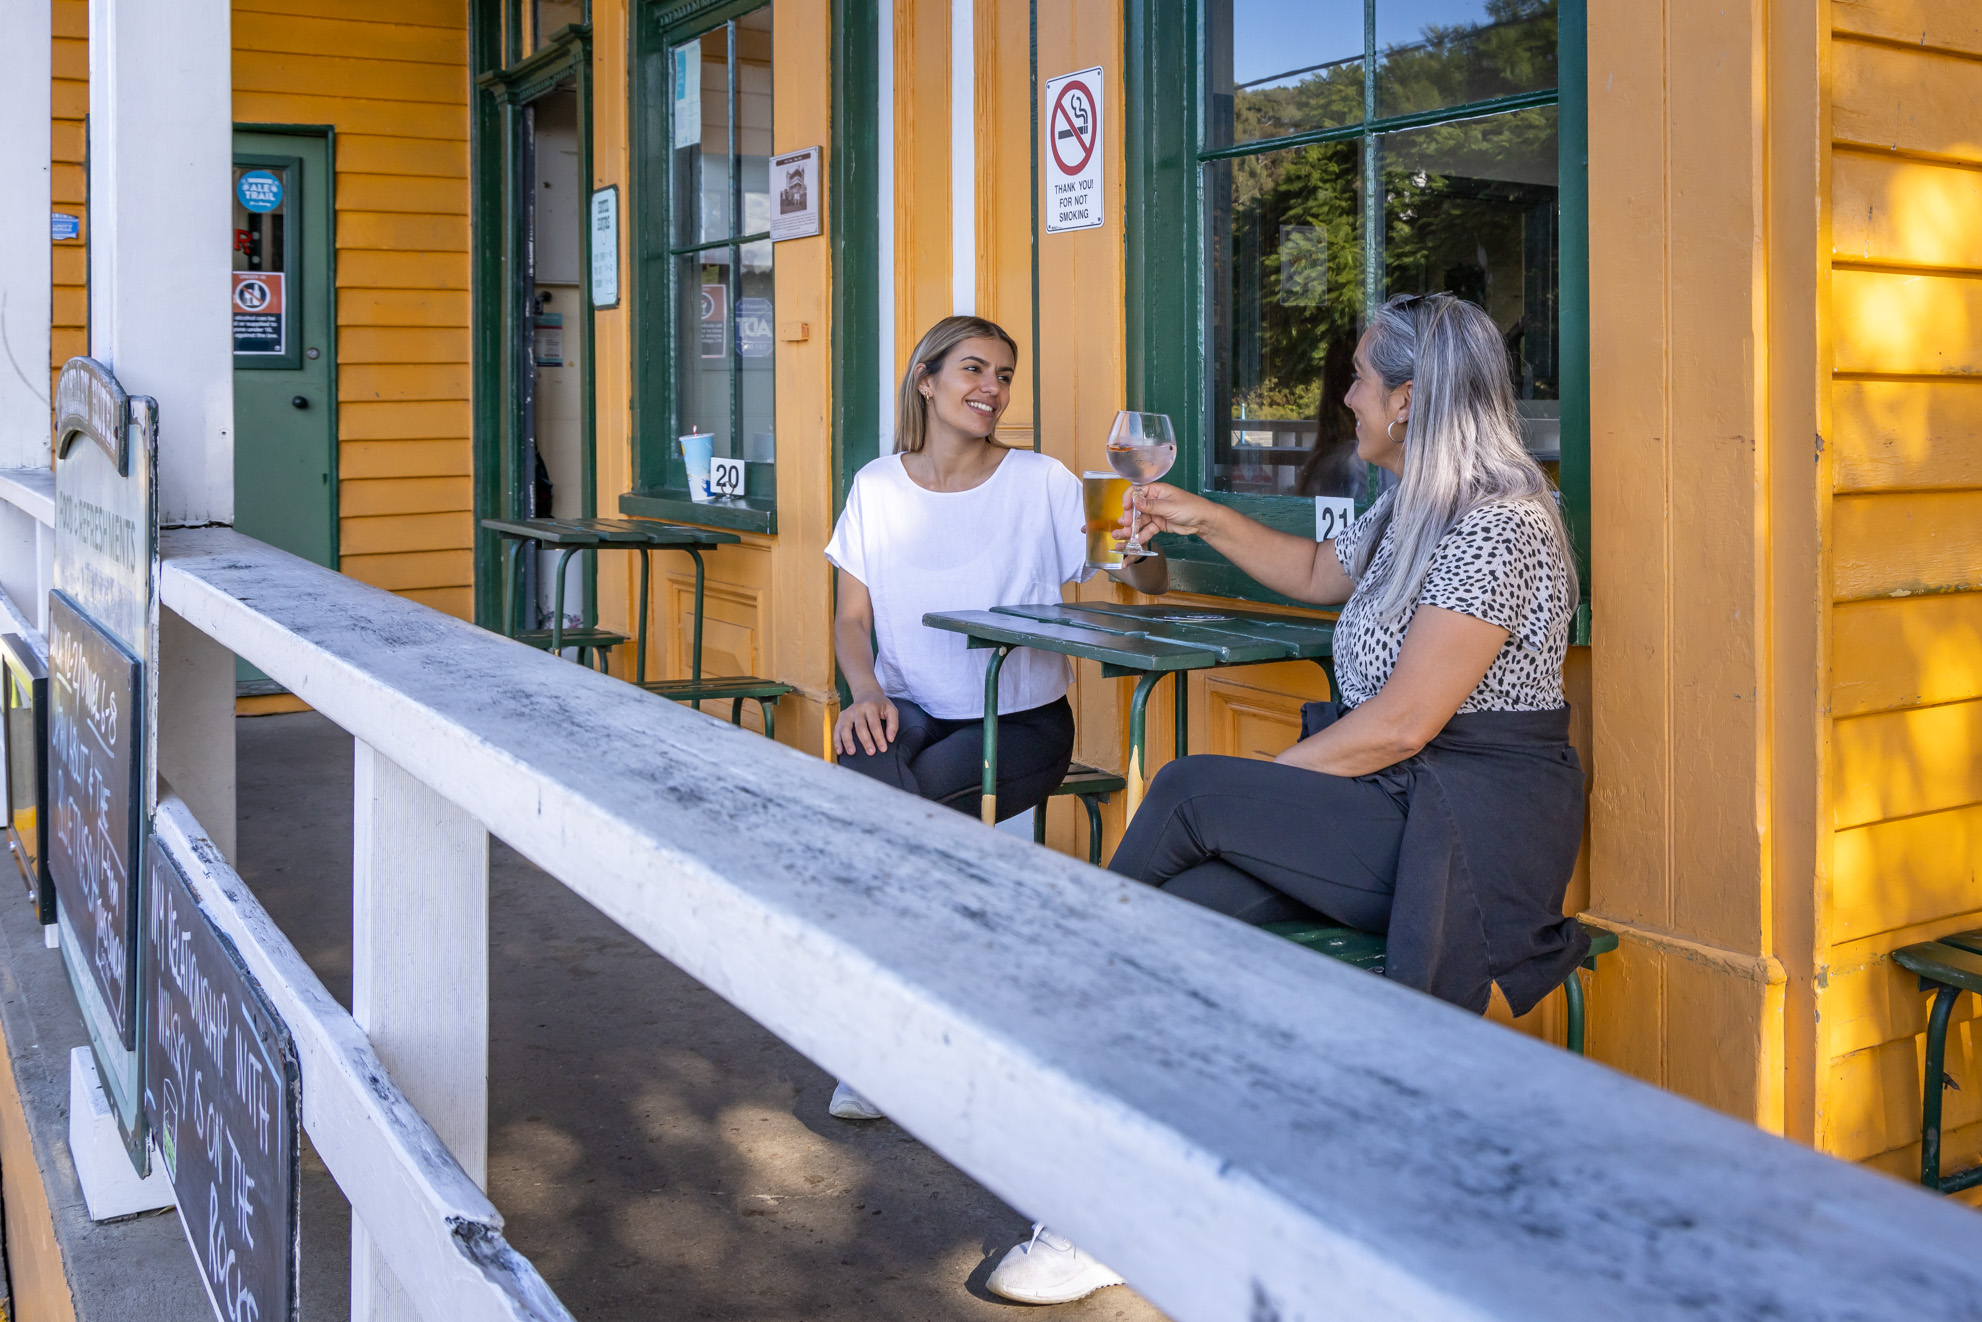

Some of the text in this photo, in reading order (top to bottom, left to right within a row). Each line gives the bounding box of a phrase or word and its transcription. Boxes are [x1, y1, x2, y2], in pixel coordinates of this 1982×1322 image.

[250, 183, 270, 192] ALE
[1054, 178, 1094, 195] THANK YOU!
[244, 190, 275, 201] TRAIL
[1059, 194, 1088, 208] FOR NOT
[1059, 208, 1089, 222] SMOKING
[716, 464, 739, 488] 20
[1322, 506, 1349, 540] 21
[151, 863, 270, 1156] MY RELATIONSHIP WITH
[158, 976, 255, 1251] WHISKY IS ON THE
